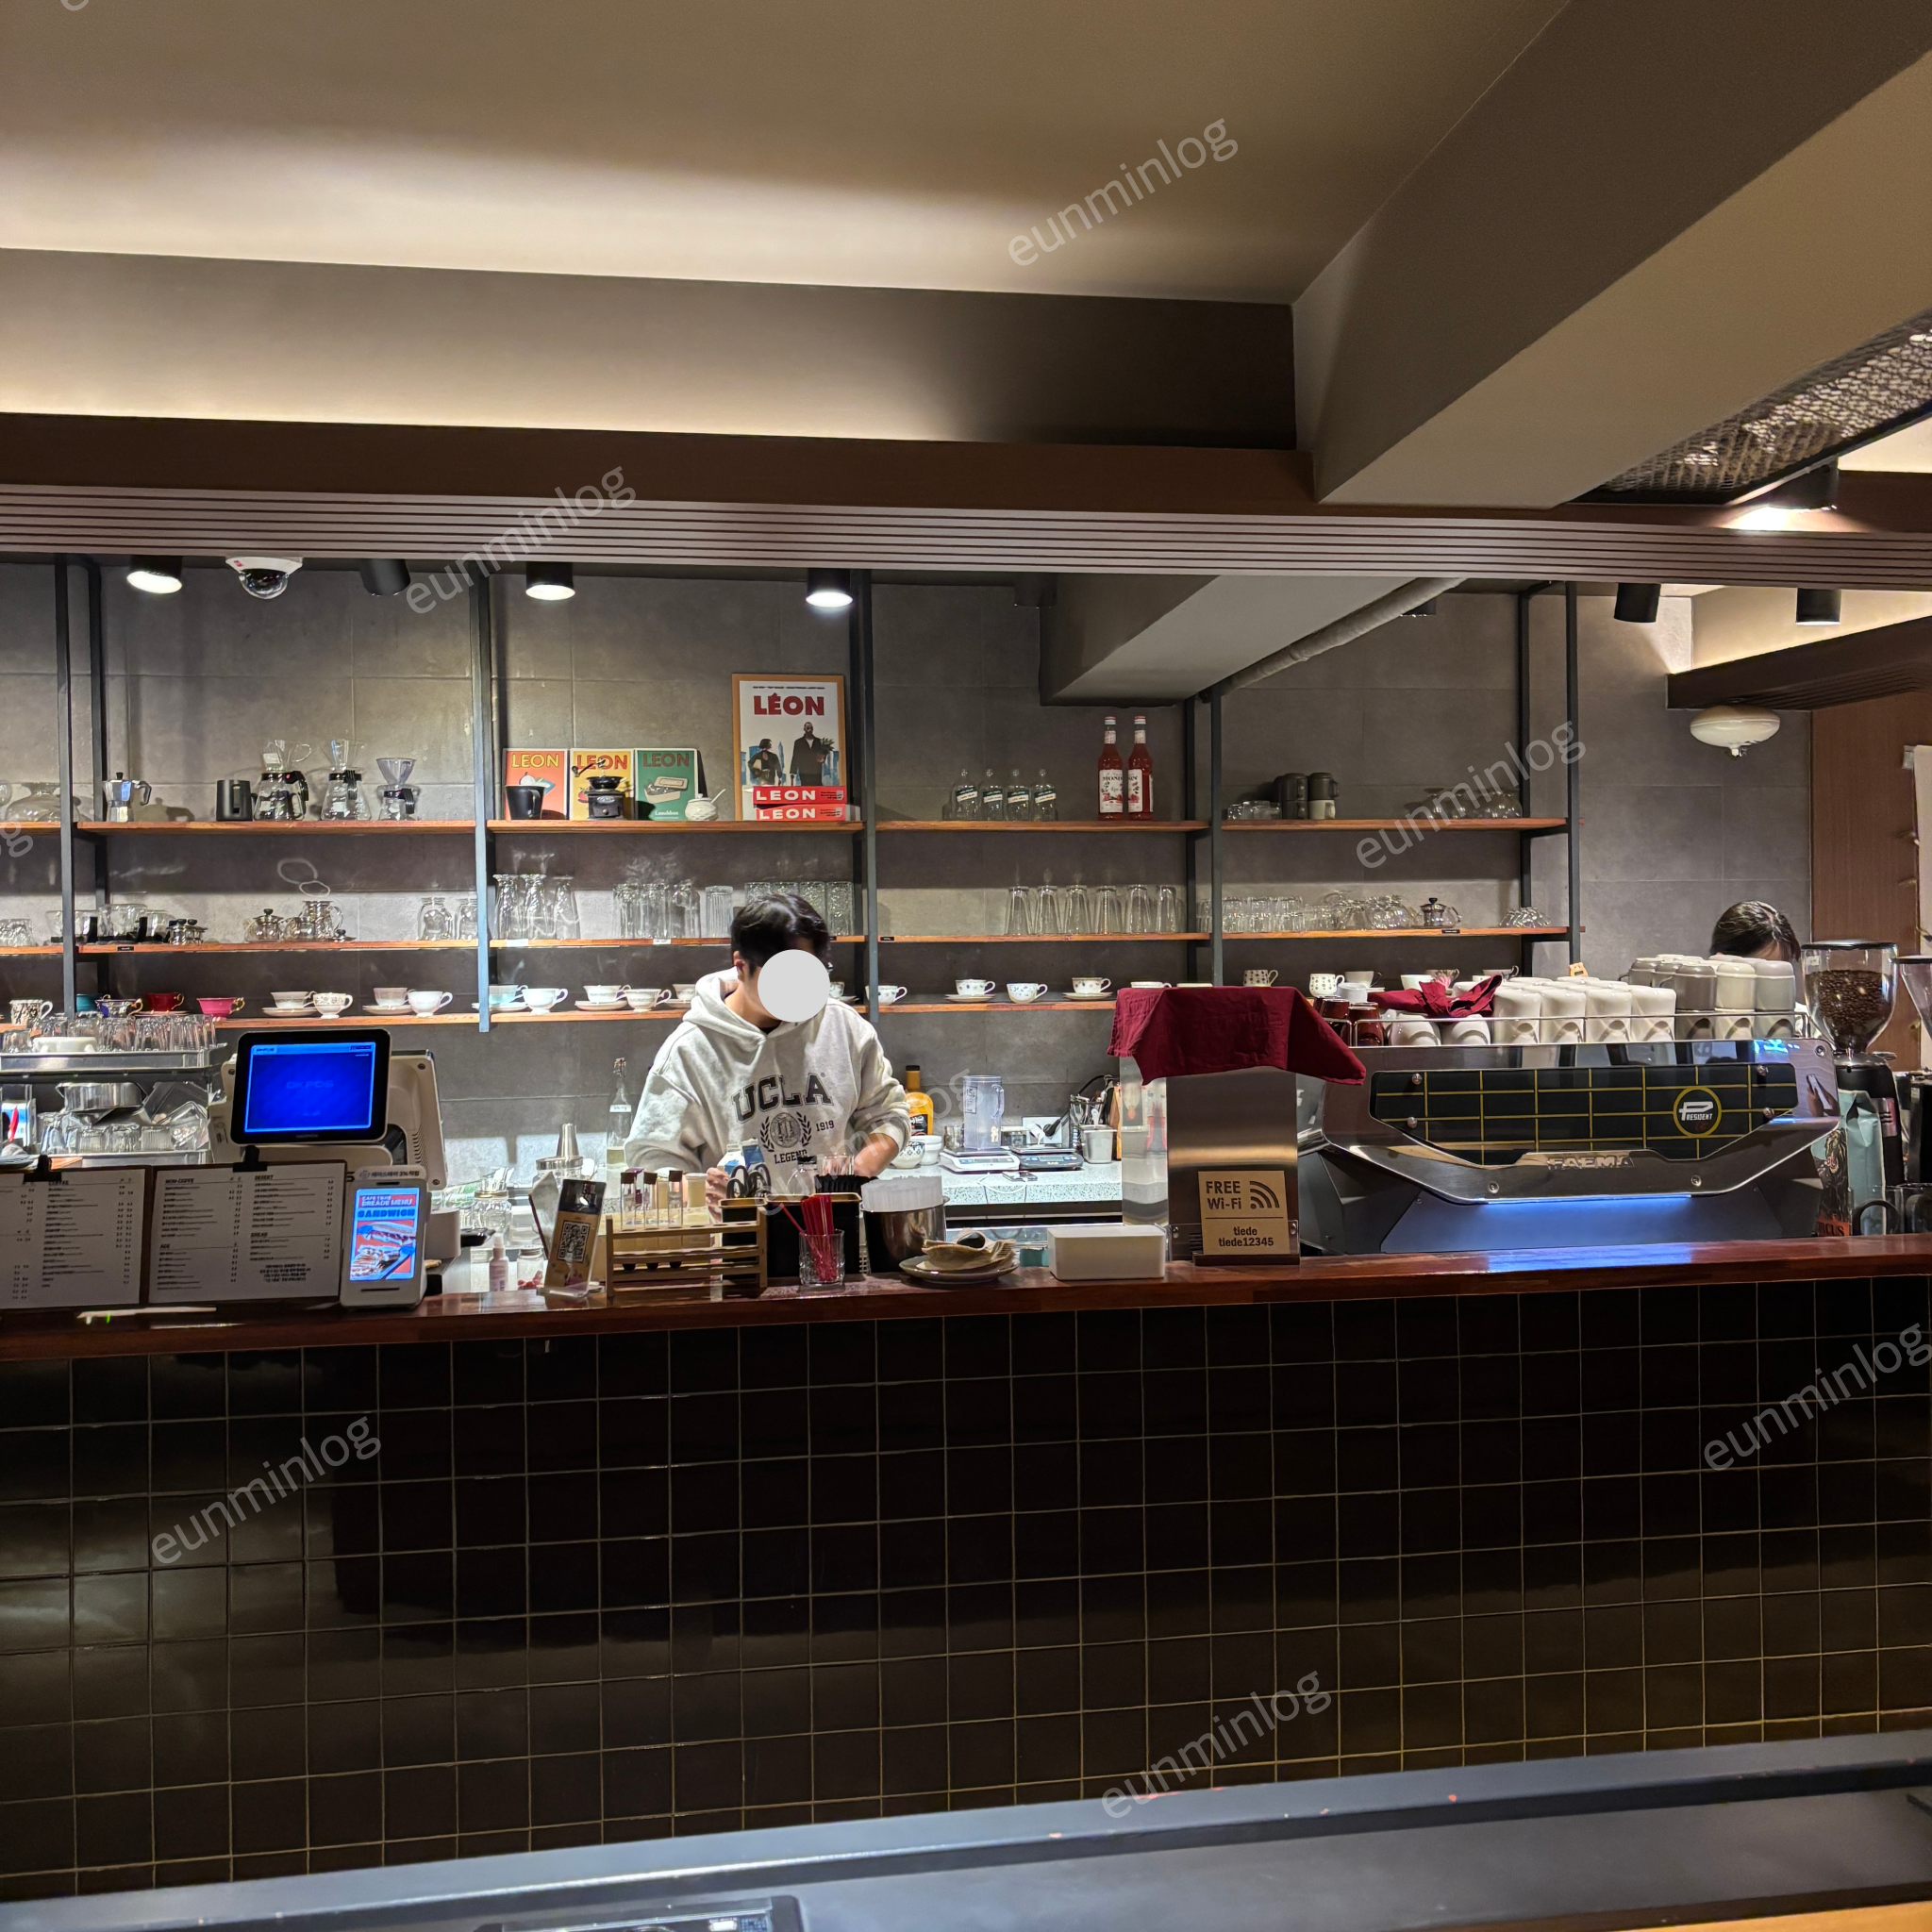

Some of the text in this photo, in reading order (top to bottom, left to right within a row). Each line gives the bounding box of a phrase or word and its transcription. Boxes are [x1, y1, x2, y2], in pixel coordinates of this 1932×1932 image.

[754, 692, 824, 716] LÉON
[511, 754, 559, 768] LEON
[576, 755, 628, 771] LEON
[642, 753, 690, 768] LEON
[756, 790, 816, 801] LEON
[758, 808, 816, 820] LEON
[731, 1073, 834, 1124] UCLA
[816, 1120, 835, 1132] 1919
[1206, 1181, 1241, 1194] FREE
[1207, 1197, 1242, 1209] Wi-Fi
[358, 1208, 416, 1218] SANDWICH
[1233, 1226, 1257, 1236] tiede
[1219, 1237, 1274, 1247] tiede12345
